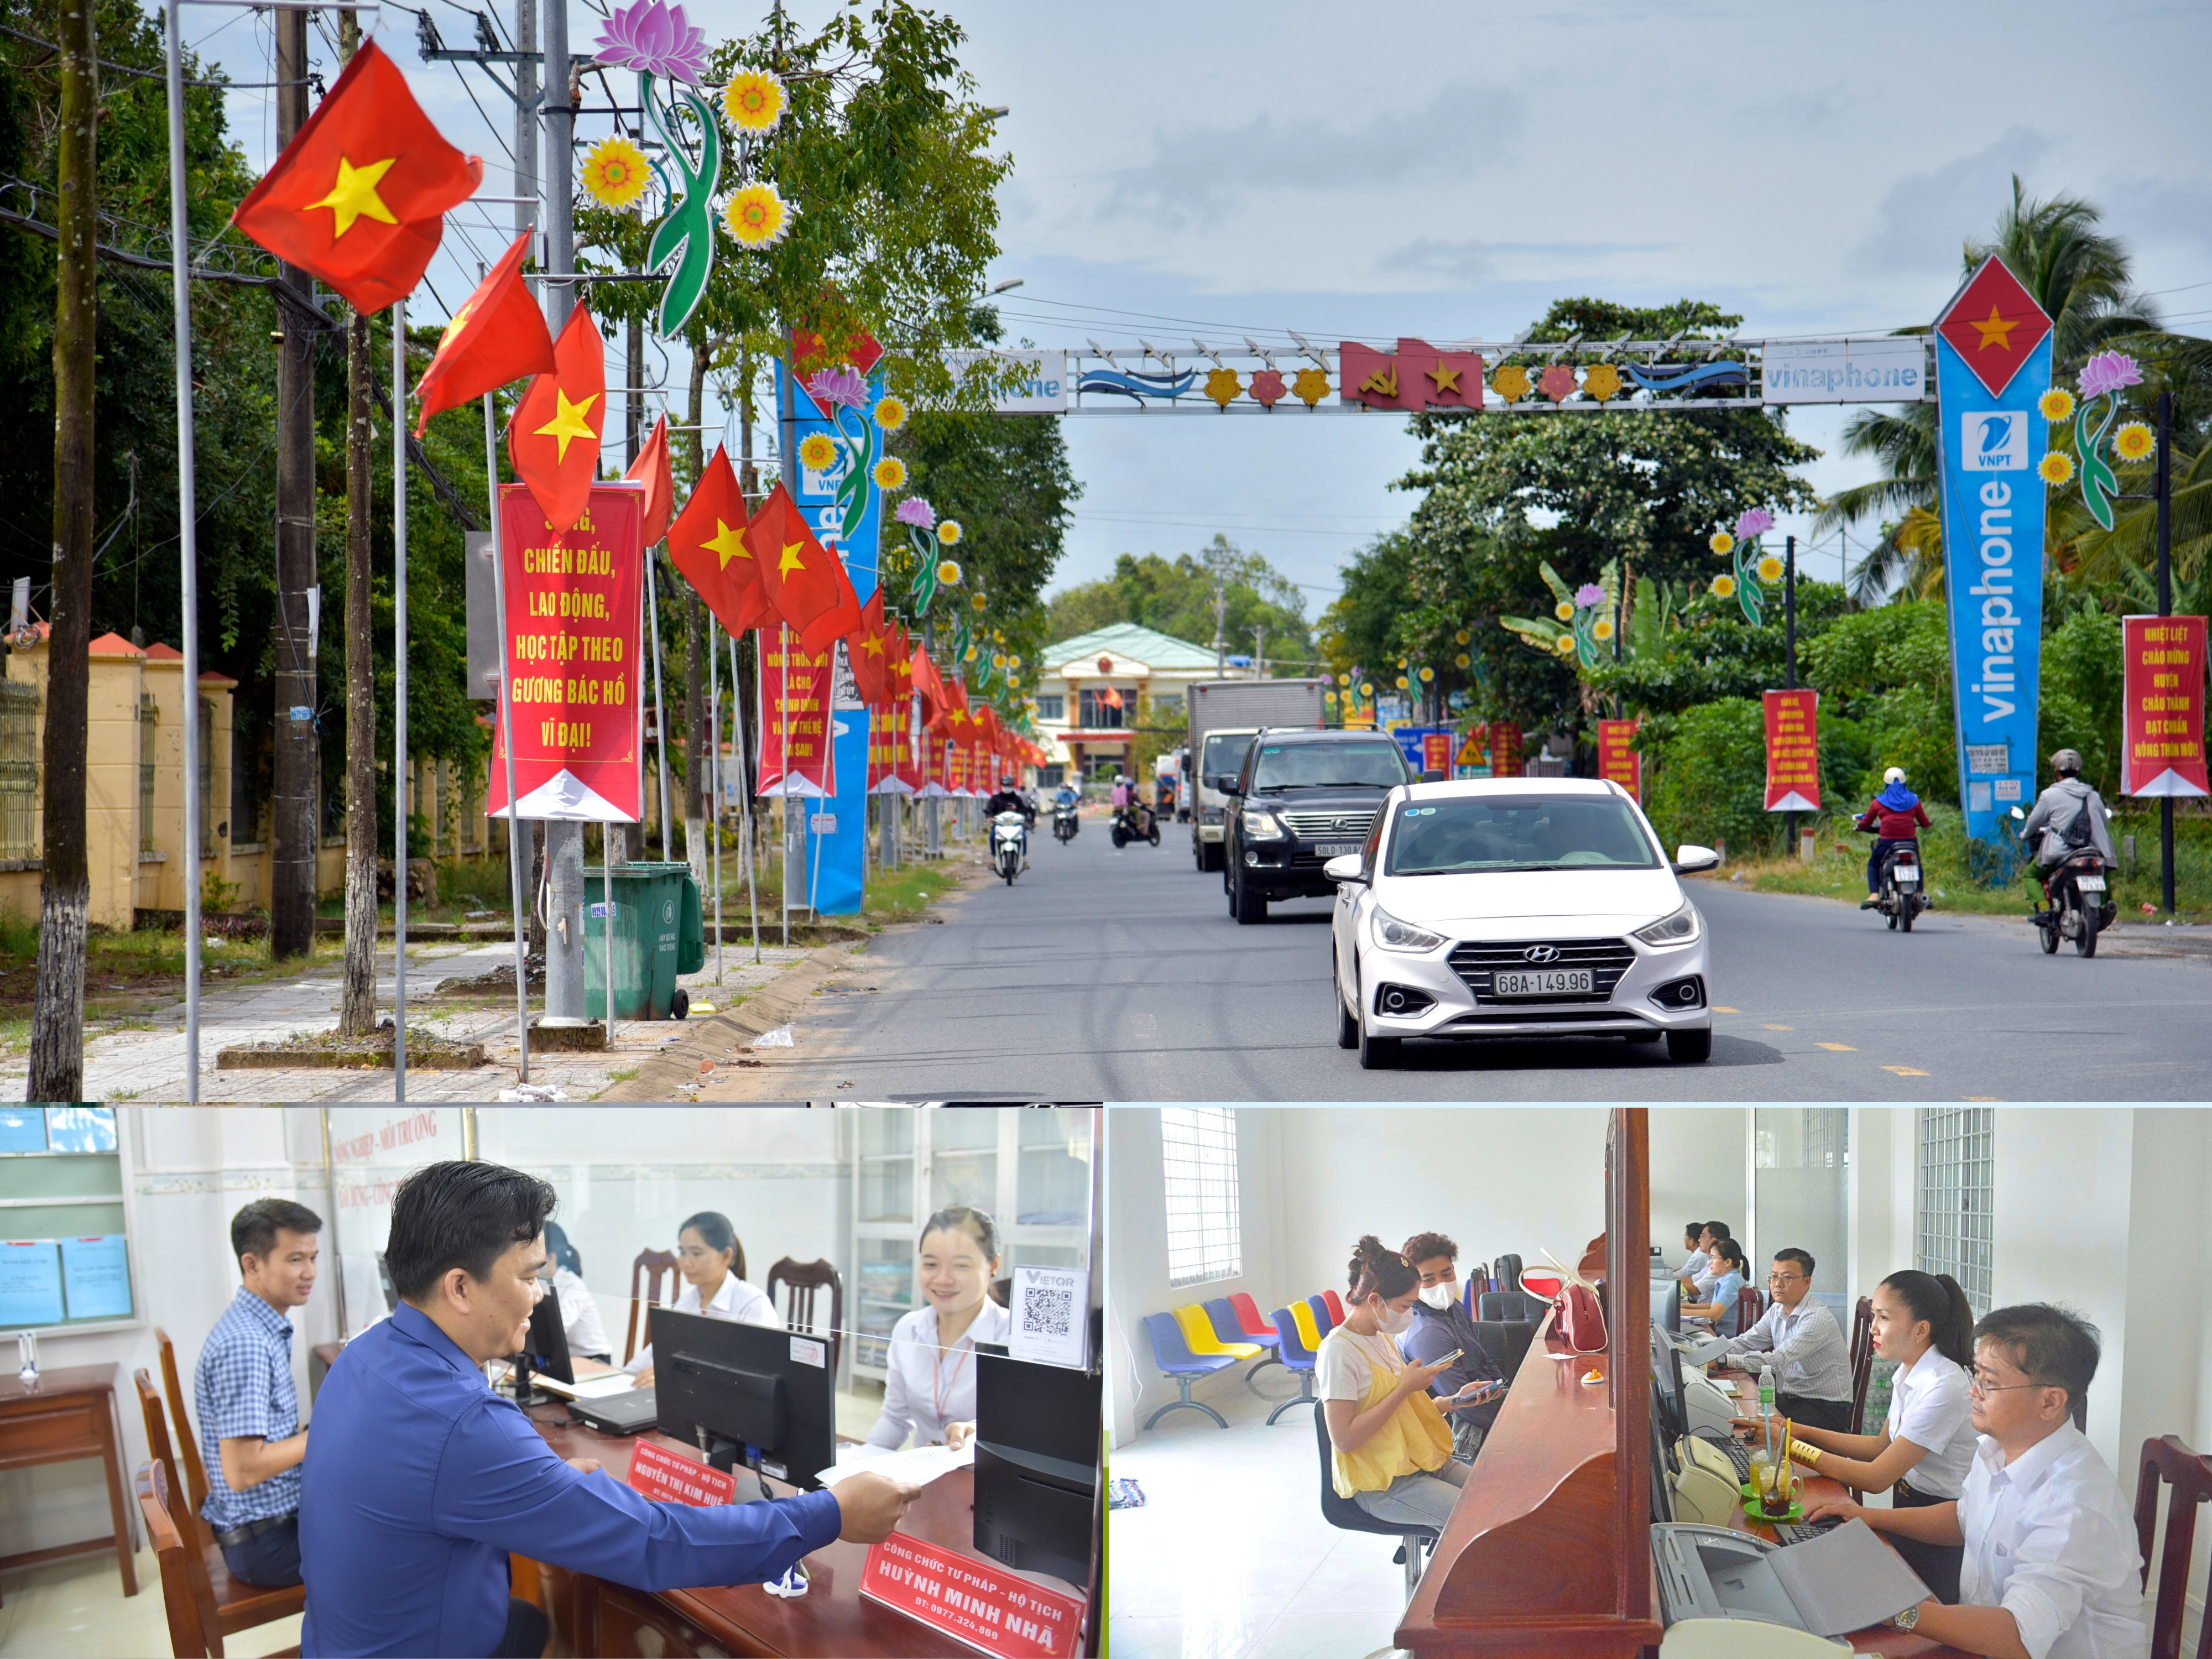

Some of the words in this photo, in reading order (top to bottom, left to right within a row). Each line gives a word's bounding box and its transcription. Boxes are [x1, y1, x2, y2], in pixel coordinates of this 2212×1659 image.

[1766, 363, 1917, 392] vinaphone
[1978, 455, 2012, 467] VNPT
[818, 479, 841, 491] VNP
[524, 541, 572, 573] CHIẾN
[576, 541, 615, 578] ĐẤU,
[529, 592, 556, 617] LAO
[560, 587, 609, 623] ĐỘNG,
[1969, 481, 2022, 724] vinaphone
[2145, 625, 2169, 644] NHIỆT
[2171, 625, 2188, 644] LIỆT
[516, 634, 546, 665] HỌC
[550, 630, 578, 666] TẬP
[582, 637, 623, 662] THEO
[2142, 648, 2165, 665] CHÀO
[512, 676, 562, 703] GƯƠNG
[567, 674, 598, 705] BÁC
[603, 672, 625, 705] HỒ
[796, 676, 811, 689] CHO
[2153, 671, 2179, 690] HUYỆN
[2142, 694, 2165, 711] CHÂU
[2167, 694, 2190, 711] THÀNH
[541, 717, 555, 747] VĨ
[558, 722, 591, 753] ĐẠI!
[784, 721, 797, 734] HO
[812, 718, 822, 737] HỆ
[2145, 720, 2162, 738] ĐẠT
[795, 743, 813, 757] SAU!
[2135, 741, 2159, 758] NÔNG
[1499, 973, 1589, 993] 68A-149.96
[397, 1108, 437, 1147] TRƯỜNG
[1026, 1270, 1074, 1287] VIETQR
[640, 1447, 655, 1459] CÔNG
[656, 1453, 671, 1466] CHỨC
[672, 1460, 681, 1469] TƯ
[680, 1464, 697, 1476] PHÁP
[701, 1473, 711, 1484] HỘ
[712, 1477, 728, 1490] TỊCH
[635, 1461, 669, 1485] NGUYỄN
[669, 1476, 684, 1494] THỊ
[684, 1483, 703, 1501] KIM
[884, 1542, 912, 1561] CÔNG
[914, 1554, 945, 1573] CHỨC
[947, 1566, 963, 1580] TƯ
[963, 1573, 997, 1593] PHÁP
[1008, 1590, 1026, 1608] HỘ
[1030, 1599, 1062, 1622] TỊCH
[879, 1559, 941, 1598] HUỲNH
[944, 1587, 1001, 1625] MINH
[1004, 1613, 1053, 1649] NHÃ
[915, 1597, 929, 1609] ĐT:
[931, 1604, 999, 1640] 0977.324.869
